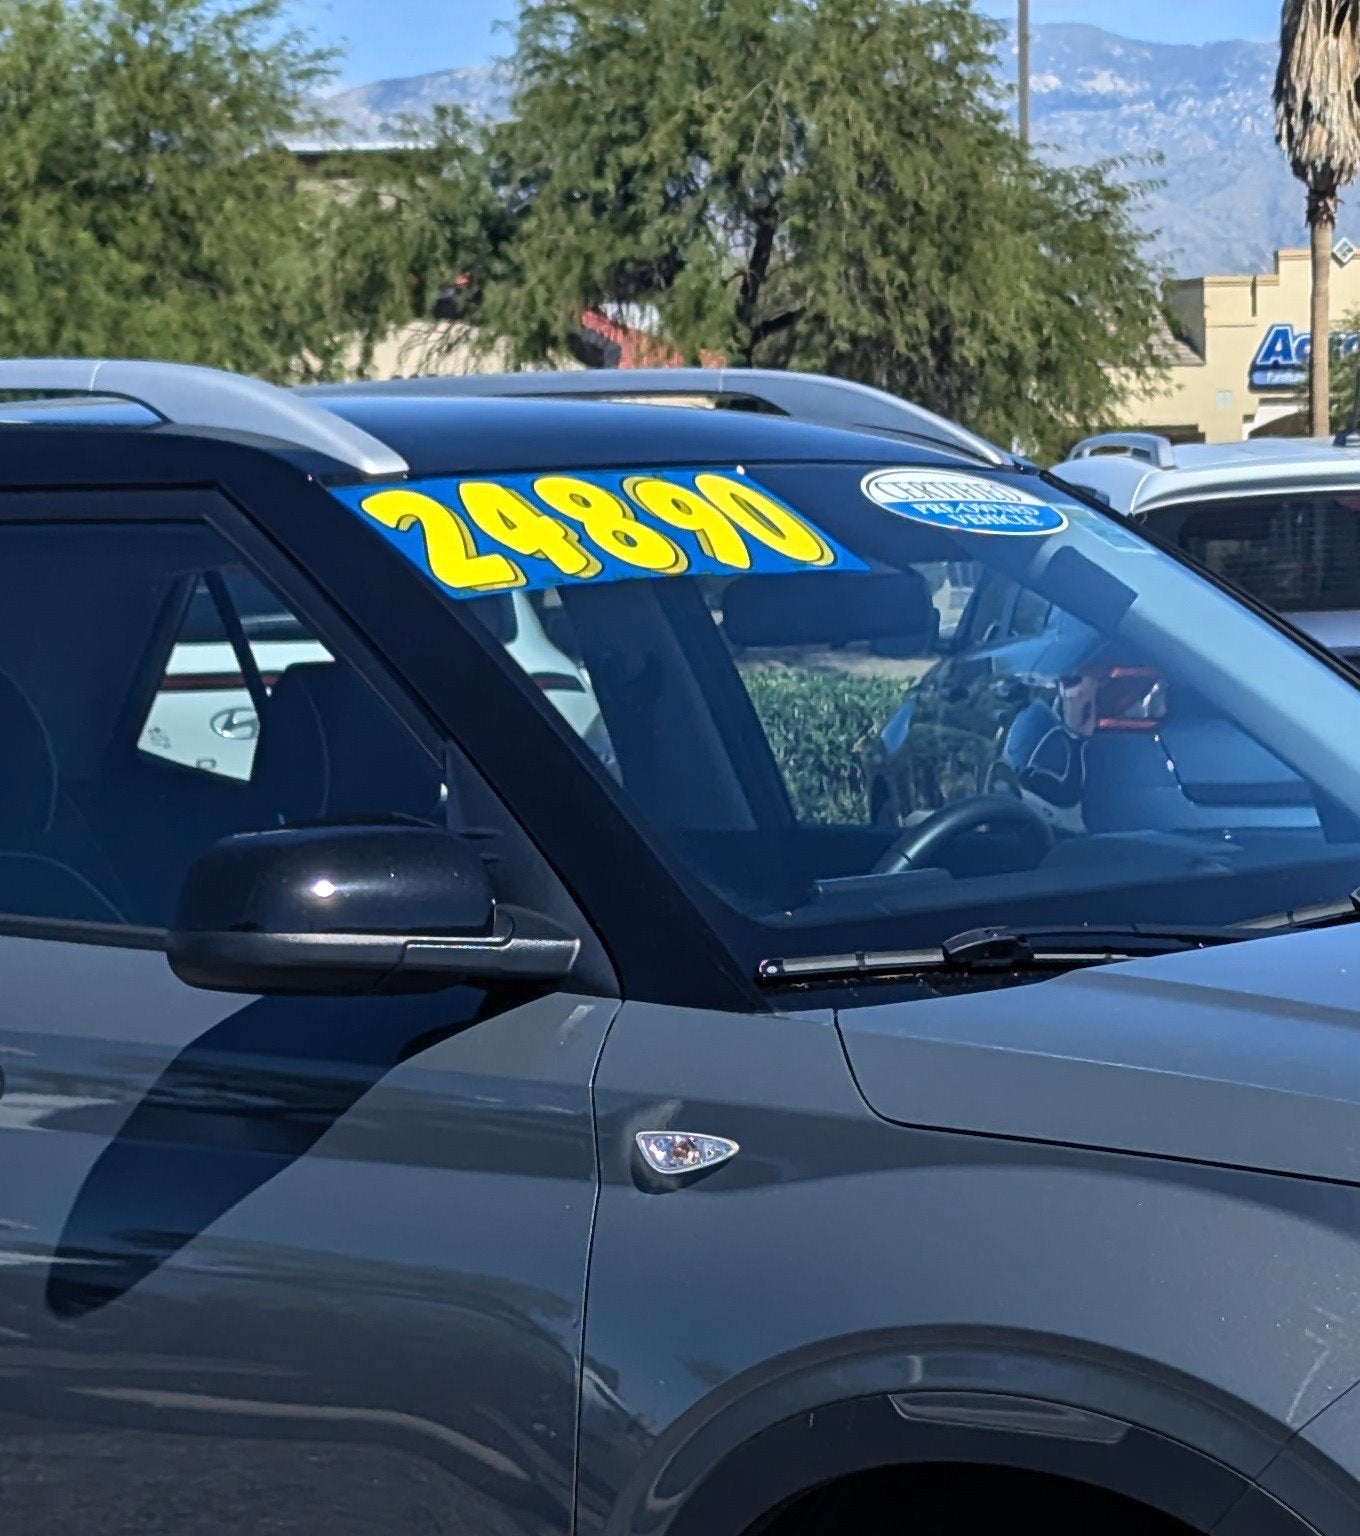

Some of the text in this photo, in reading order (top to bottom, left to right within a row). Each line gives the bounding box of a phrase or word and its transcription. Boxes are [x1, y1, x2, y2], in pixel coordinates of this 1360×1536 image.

[874, 481, 1024, 502] CERTIFIED
[948, 513, 1044, 526] VEHICLE
[360, 474, 835, 591] 24890
